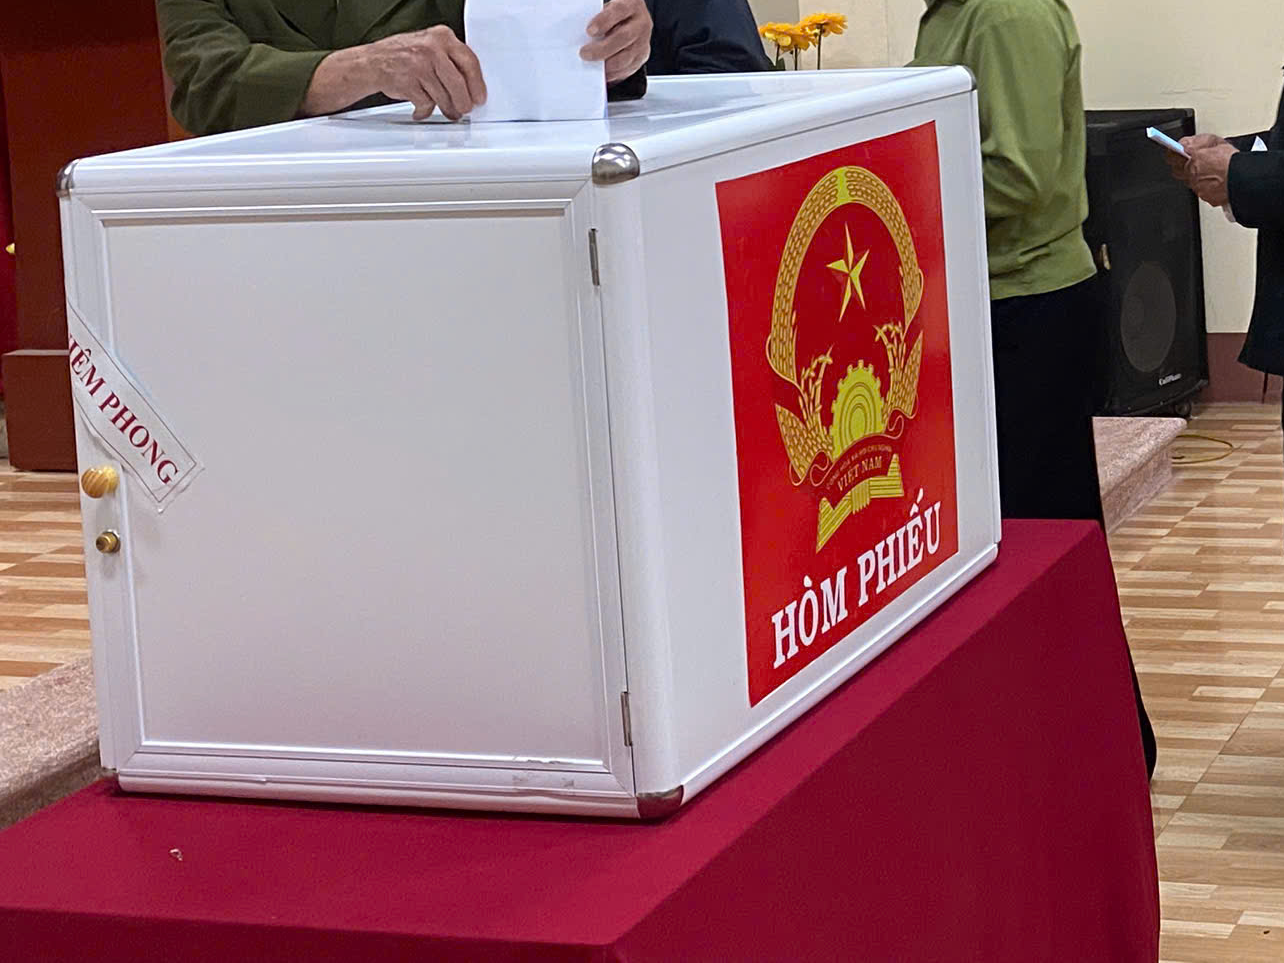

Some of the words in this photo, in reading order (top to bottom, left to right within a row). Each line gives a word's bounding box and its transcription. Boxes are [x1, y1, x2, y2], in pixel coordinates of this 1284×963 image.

[98, 391, 178, 484] PHONG
[861, 455, 883, 474] NAM
[771, 566, 848, 670] HÒM
[857, 488, 941, 607] PHIẾU
